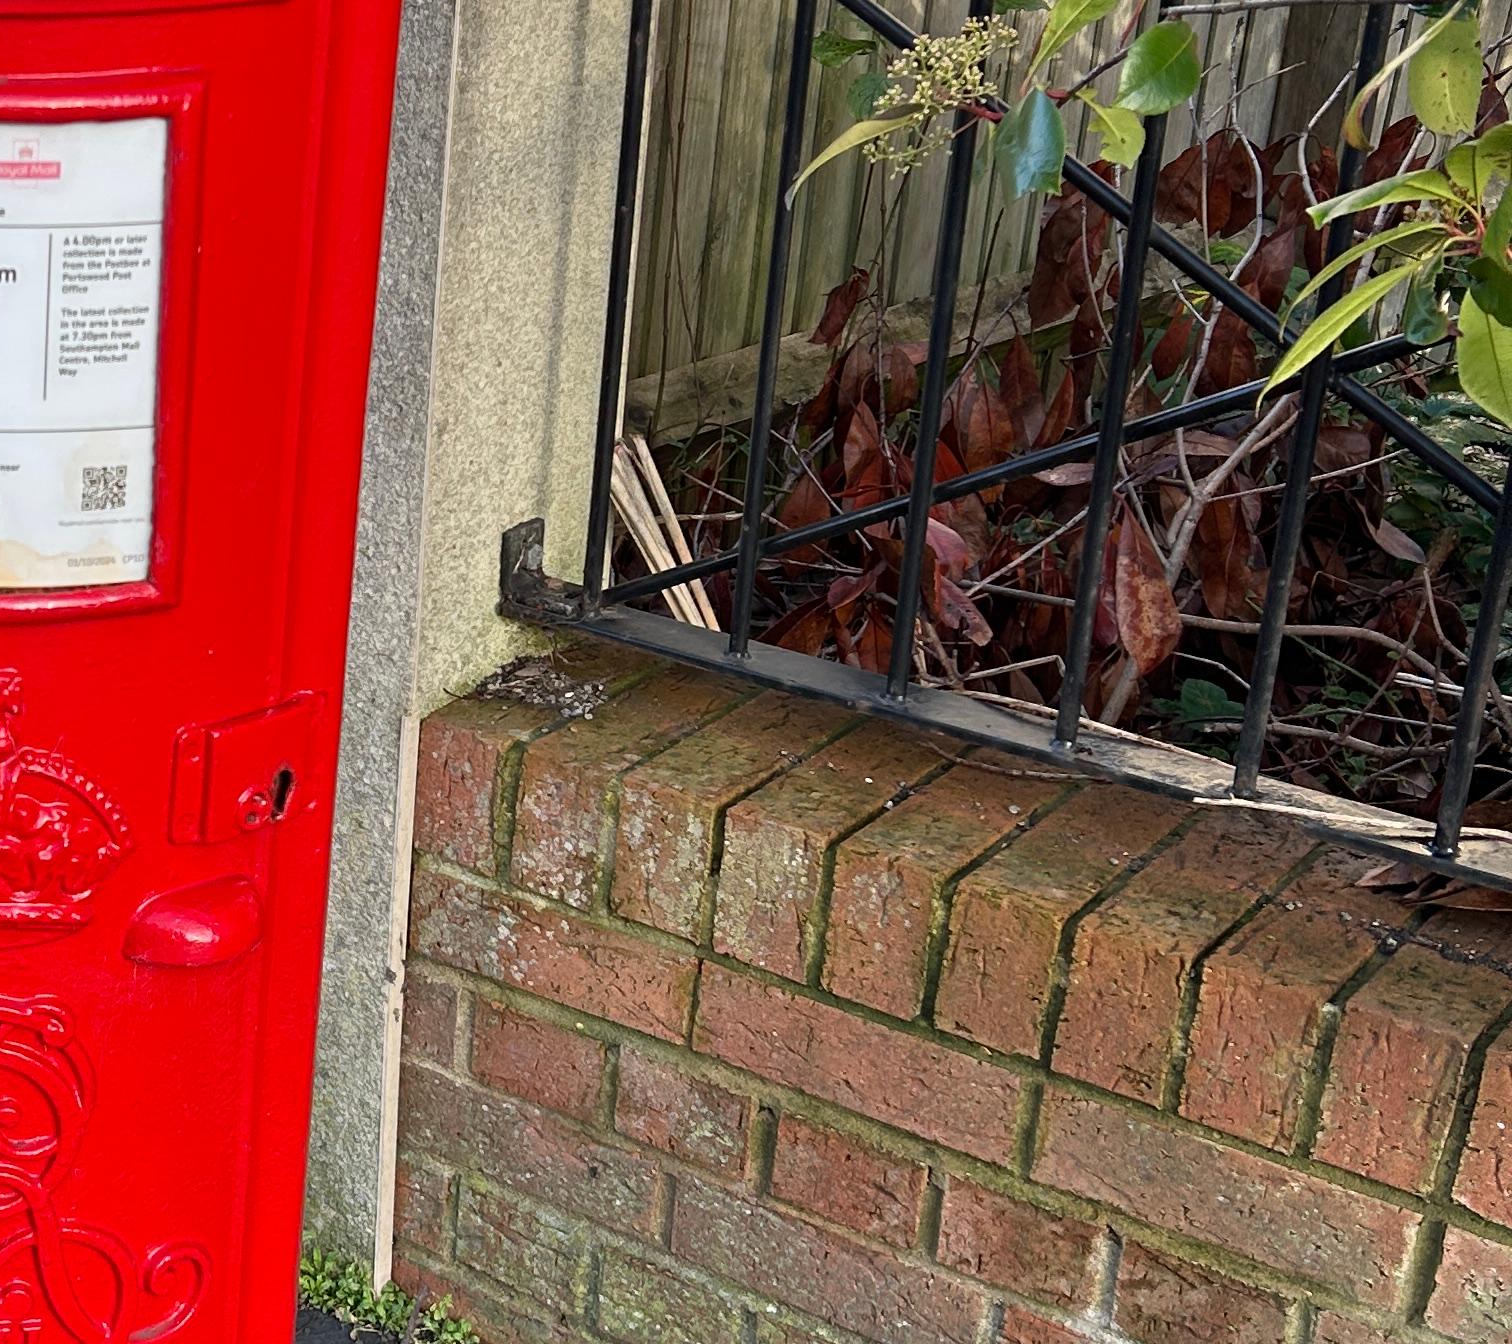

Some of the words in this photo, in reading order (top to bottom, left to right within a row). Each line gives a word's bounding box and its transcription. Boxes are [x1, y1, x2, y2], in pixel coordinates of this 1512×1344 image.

[30, 162, 57, 176] Mail
[62, 248, 106, 257] collection
[118, 247, 143, 256] made
[62, 261, 85, 270] from
[87, 259, 102, 269] the
[61, 307, 78, 317] The
[108, 305, 150, 315] collection
[71, 320, 87, 329] the
[121, 318, 146, 327] made
